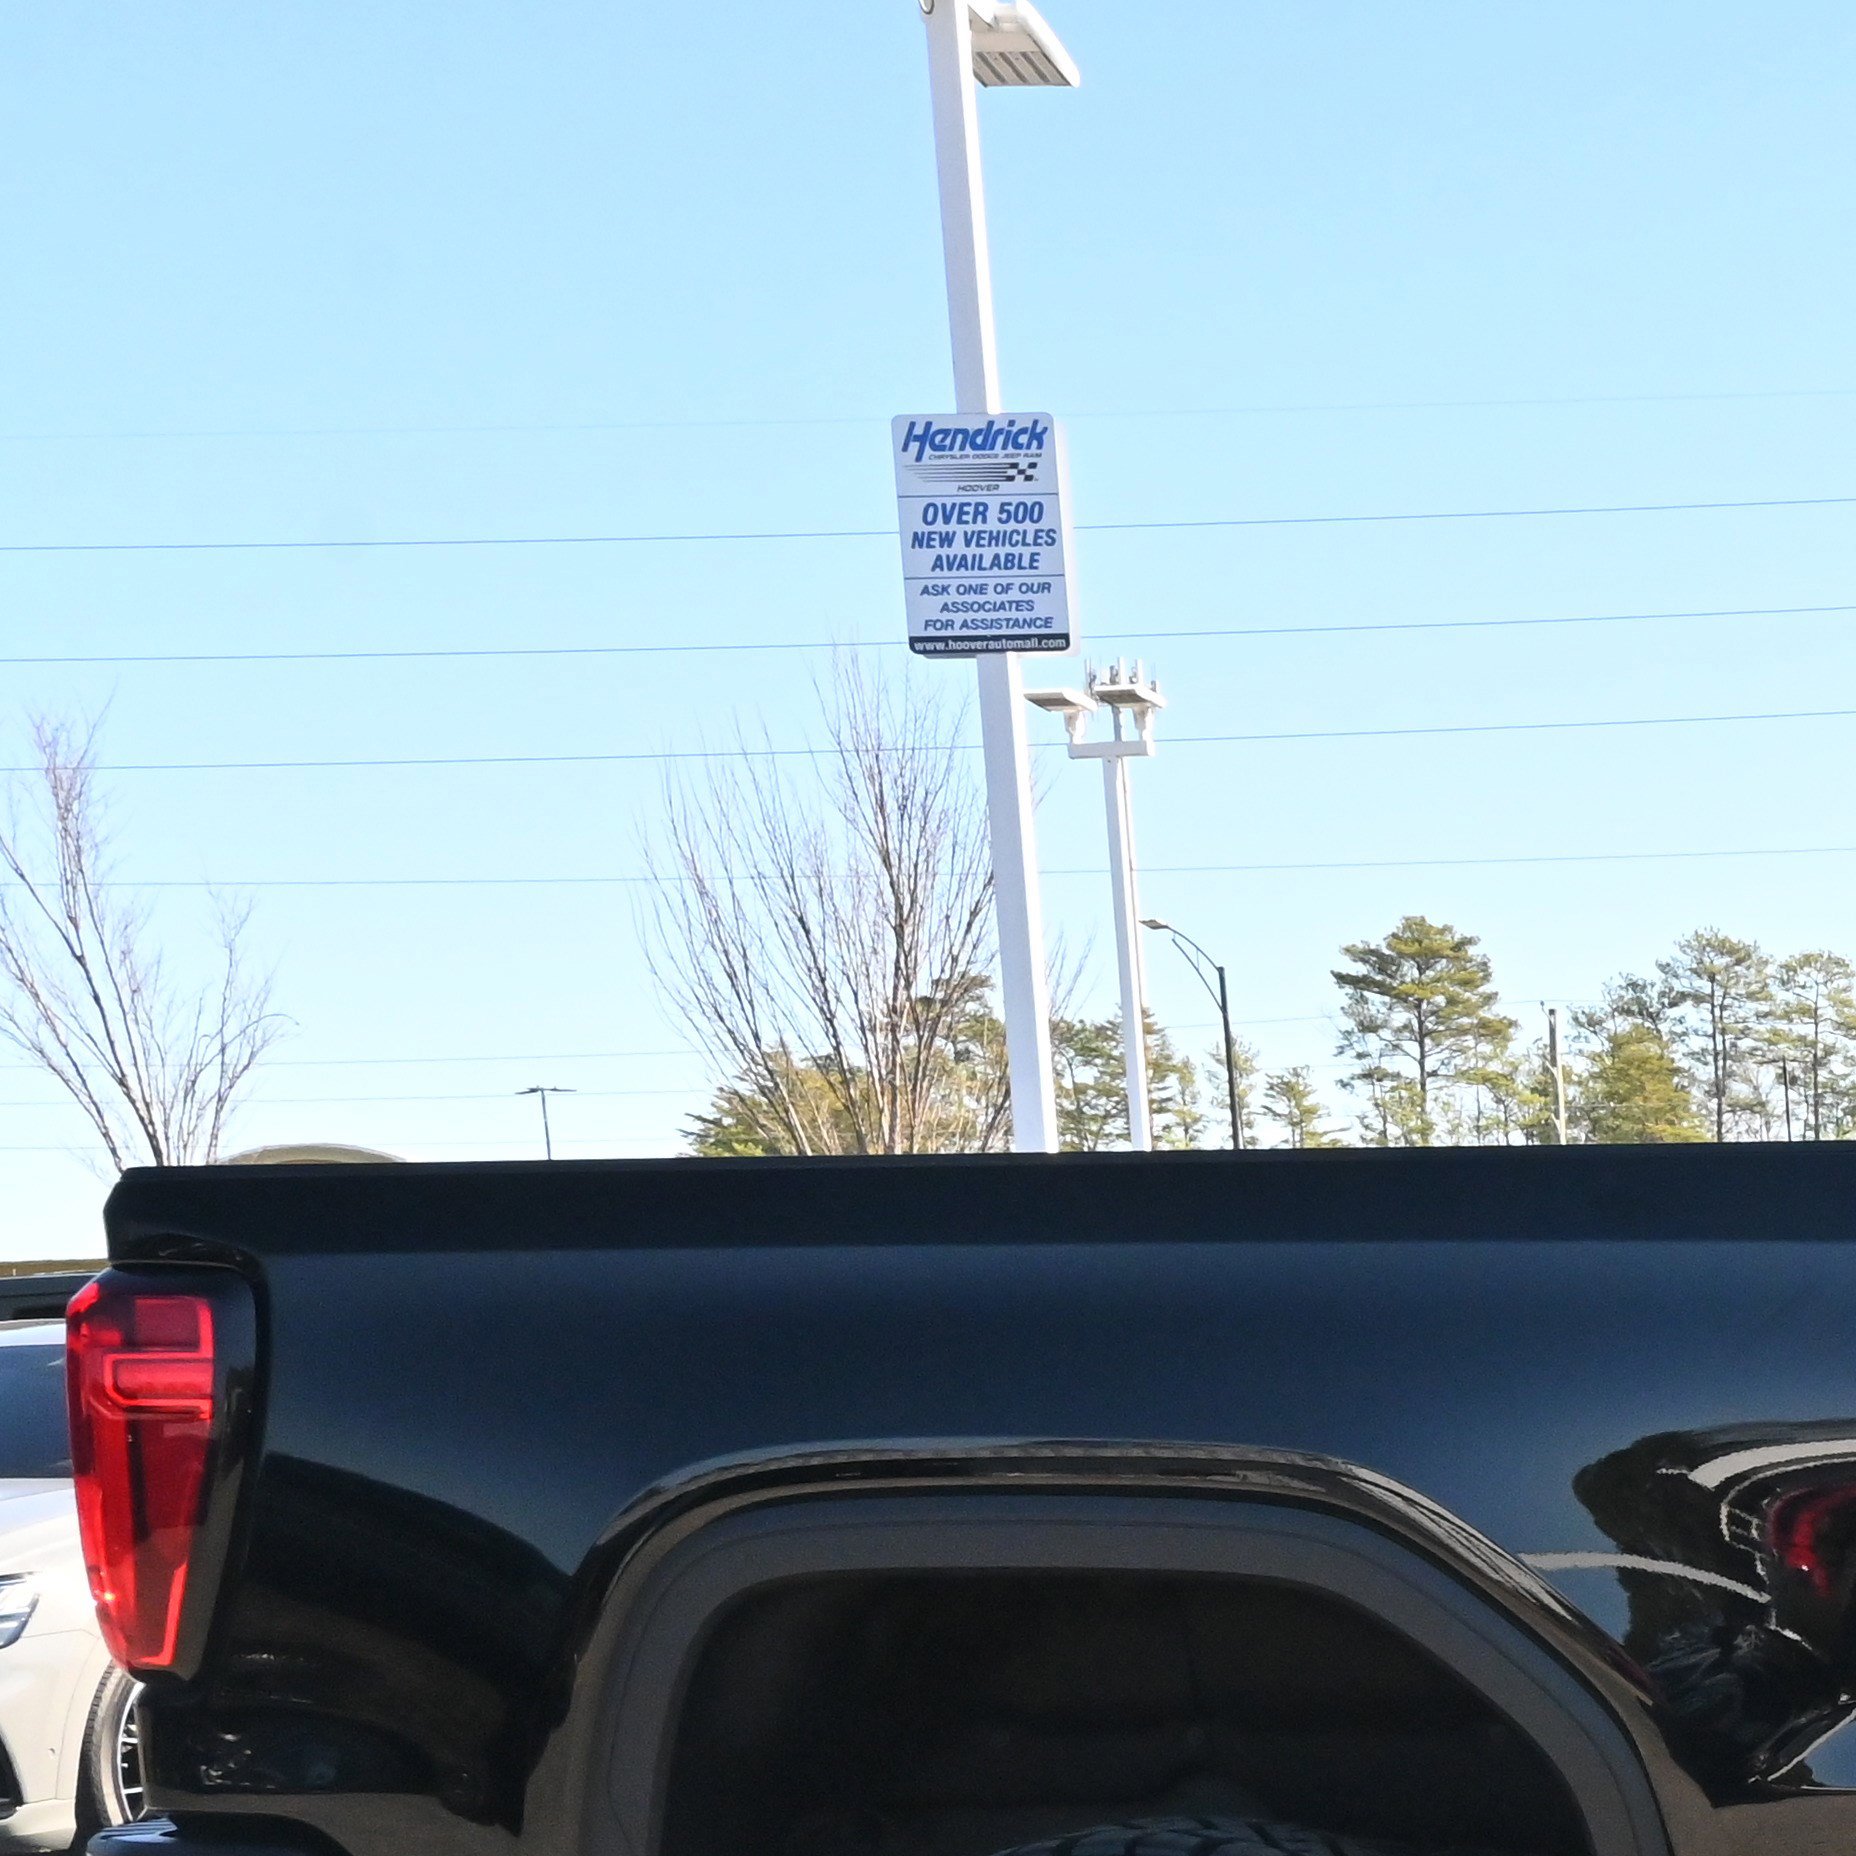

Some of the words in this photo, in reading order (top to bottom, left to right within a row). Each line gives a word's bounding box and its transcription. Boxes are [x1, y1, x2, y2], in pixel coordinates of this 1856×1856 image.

[901, 419, 1048, 462] Hendrick
[957, 484, 1000, 492] HOOVER
[922, 502, 989, 526] OVER
[997, 501, 1044, 524] 500
[911, 531, 956, 549] NEW
[964, 529, 1057, 548] VEHICLES
[931, 552, 1041, 572] AVAILABLE
[920, 584, 951, 596] ASK
[956, 583, 989, 595] ONE
[993, 583, 1014, 595] OF
[1019, 582, 1052, 594] OUR
[940, 600, 1035, 613] ASSOCIATES
[924, 619, 954, 631] FOR
[959, 616, 1054, 630] ASSISTANCE
[914, 638, 1066, 652] www.hooverautomall.com
